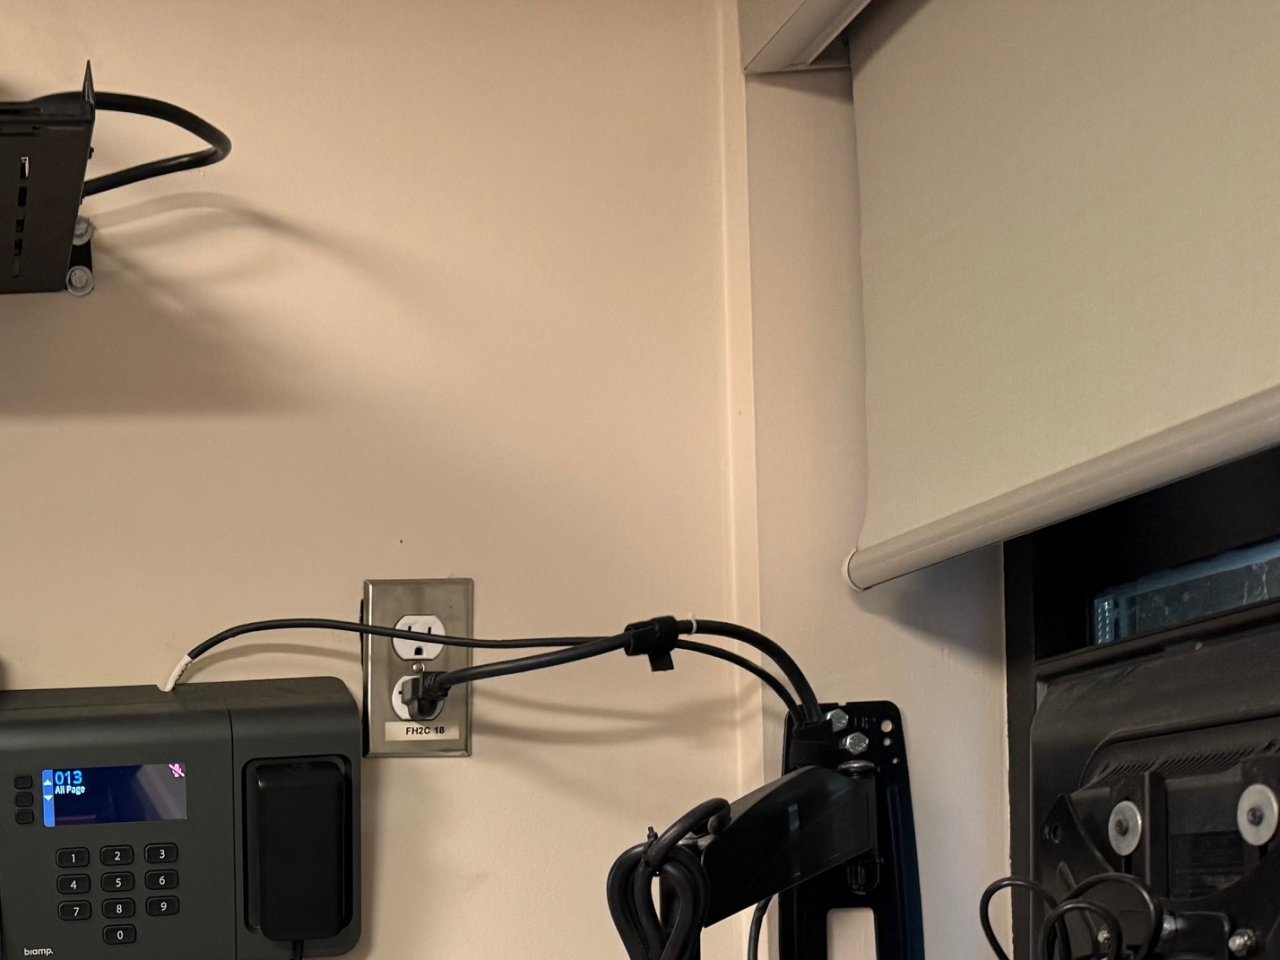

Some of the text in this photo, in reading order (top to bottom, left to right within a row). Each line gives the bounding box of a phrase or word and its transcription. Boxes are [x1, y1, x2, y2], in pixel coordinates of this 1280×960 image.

[406, 727, 431, 735] FH2C
[55, 771, 83, 785] 013
[55, 786, 85, 795] All Page
[72, 854, 75, 863] 1
[115, 851, 120, 861] 2
[160, 850, 165, 859] 3
[71, 881, 77, 889] 4
[116, 878, 121, 887] 5
[159, 876, 165, 885] 6
[116, 904, 122, 914] 8
[160, 902, 167, 911] 9
[74, 907, 79, 916] 7
[117, 930, 123, 940] 0
